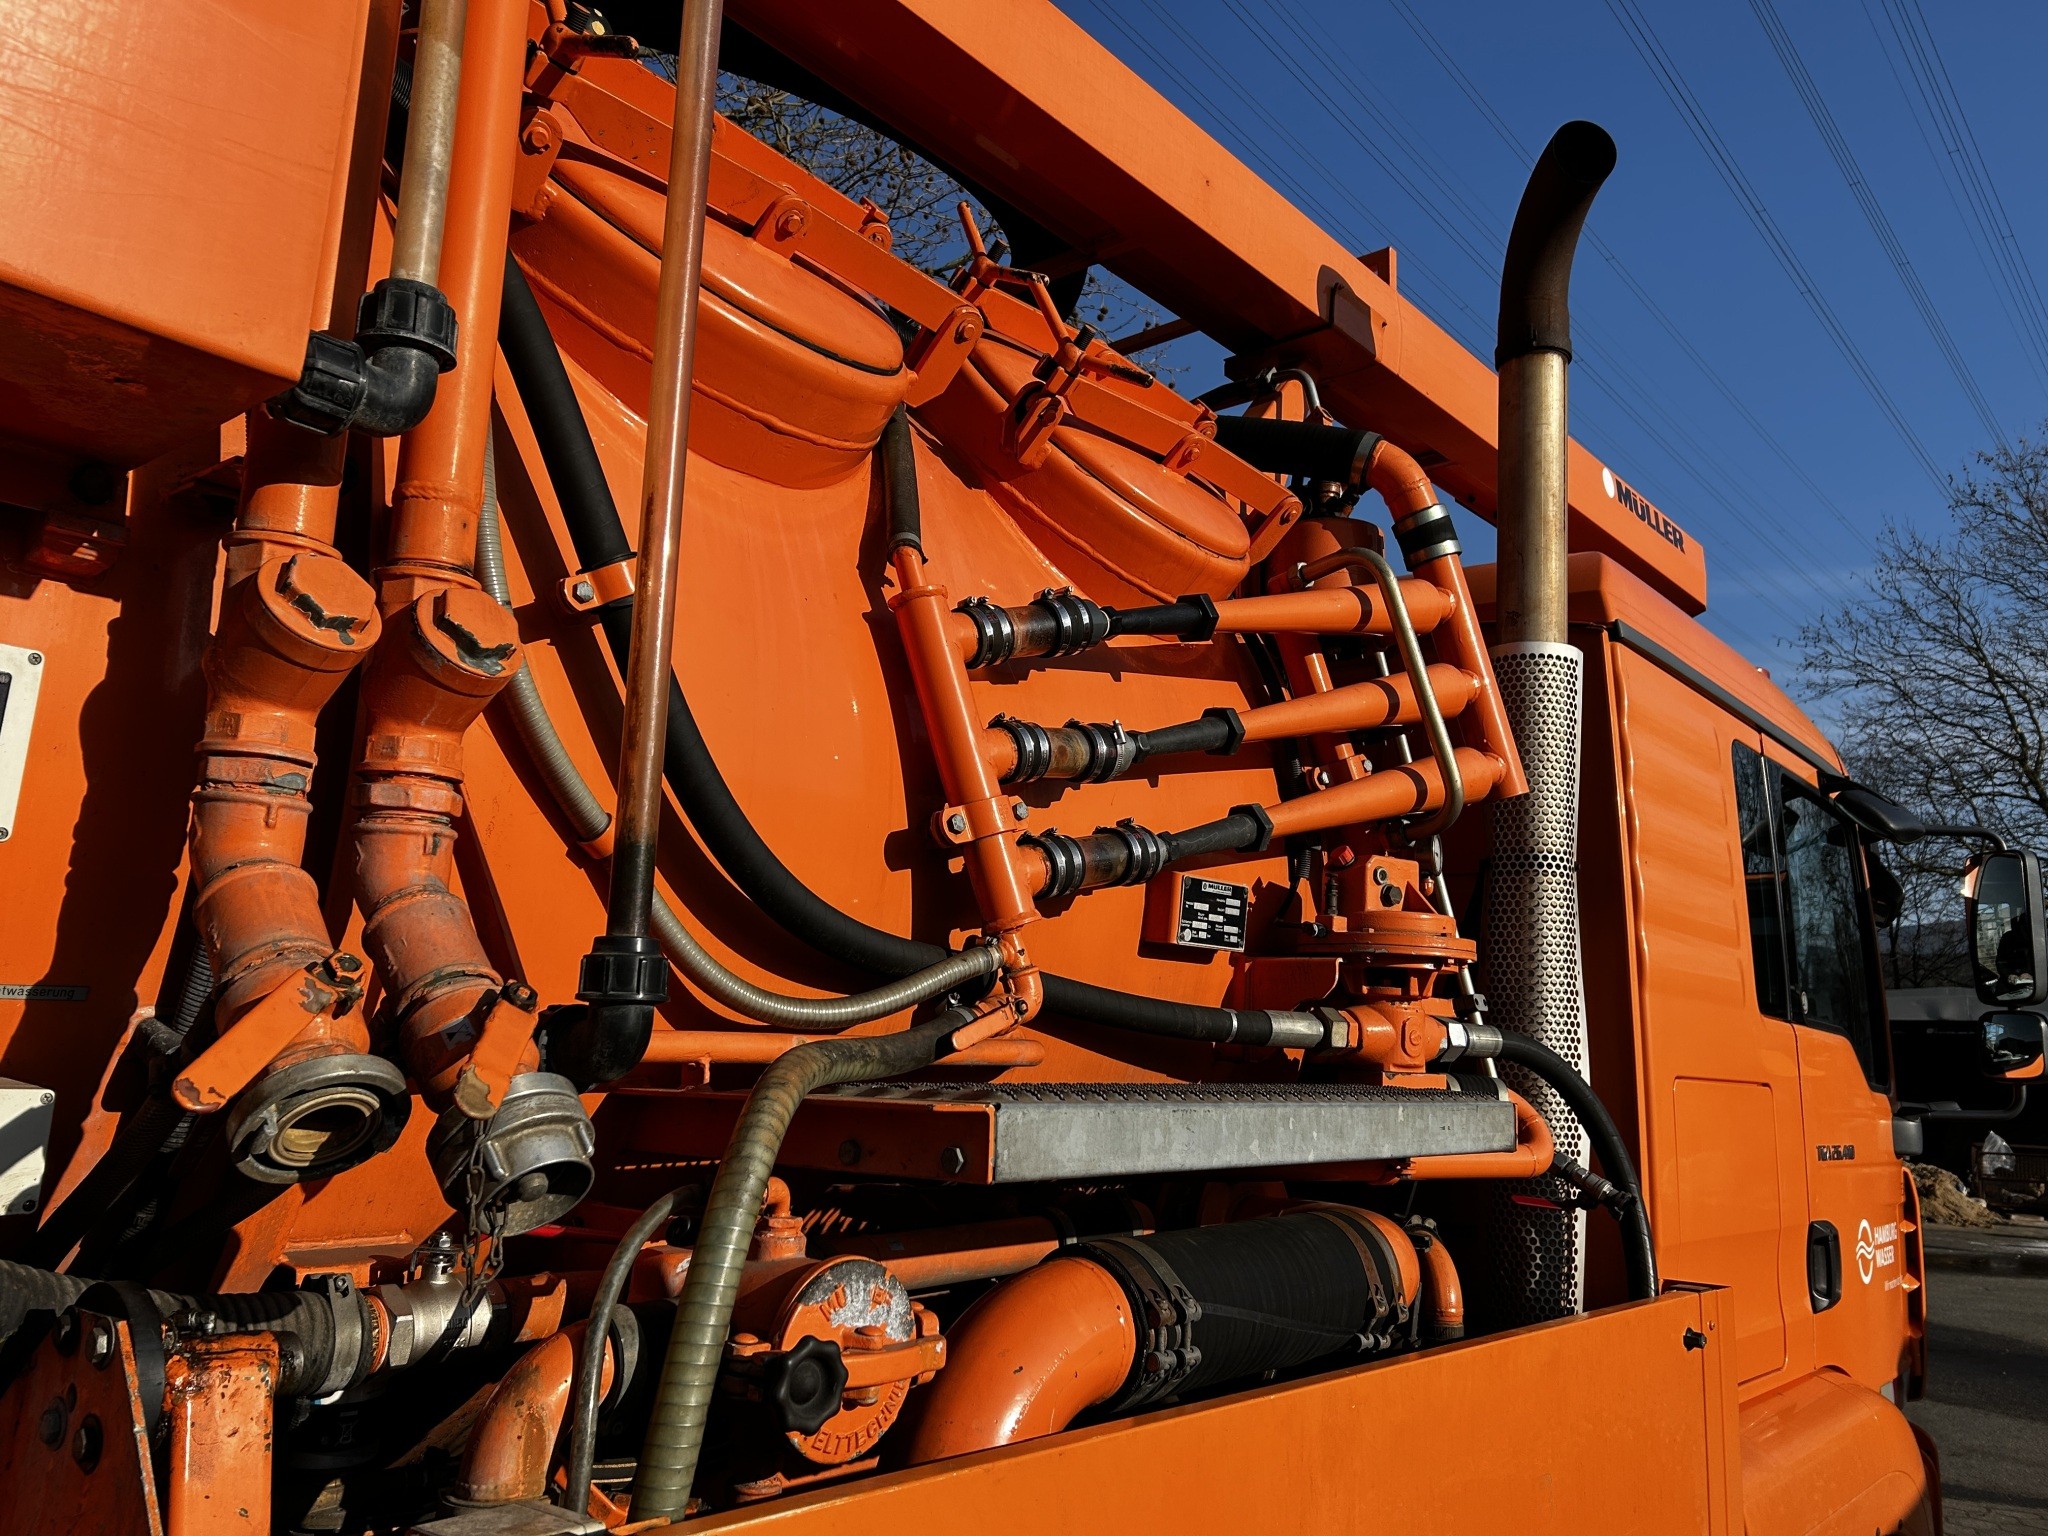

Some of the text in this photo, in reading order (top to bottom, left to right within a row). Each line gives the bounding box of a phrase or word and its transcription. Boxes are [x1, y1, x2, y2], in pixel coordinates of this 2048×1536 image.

[1615, 478, 1686, 554] MÜLLER
[0, 985, 75, 999] twässerung
[1876, 1245, 1895, 1268] WASSER
